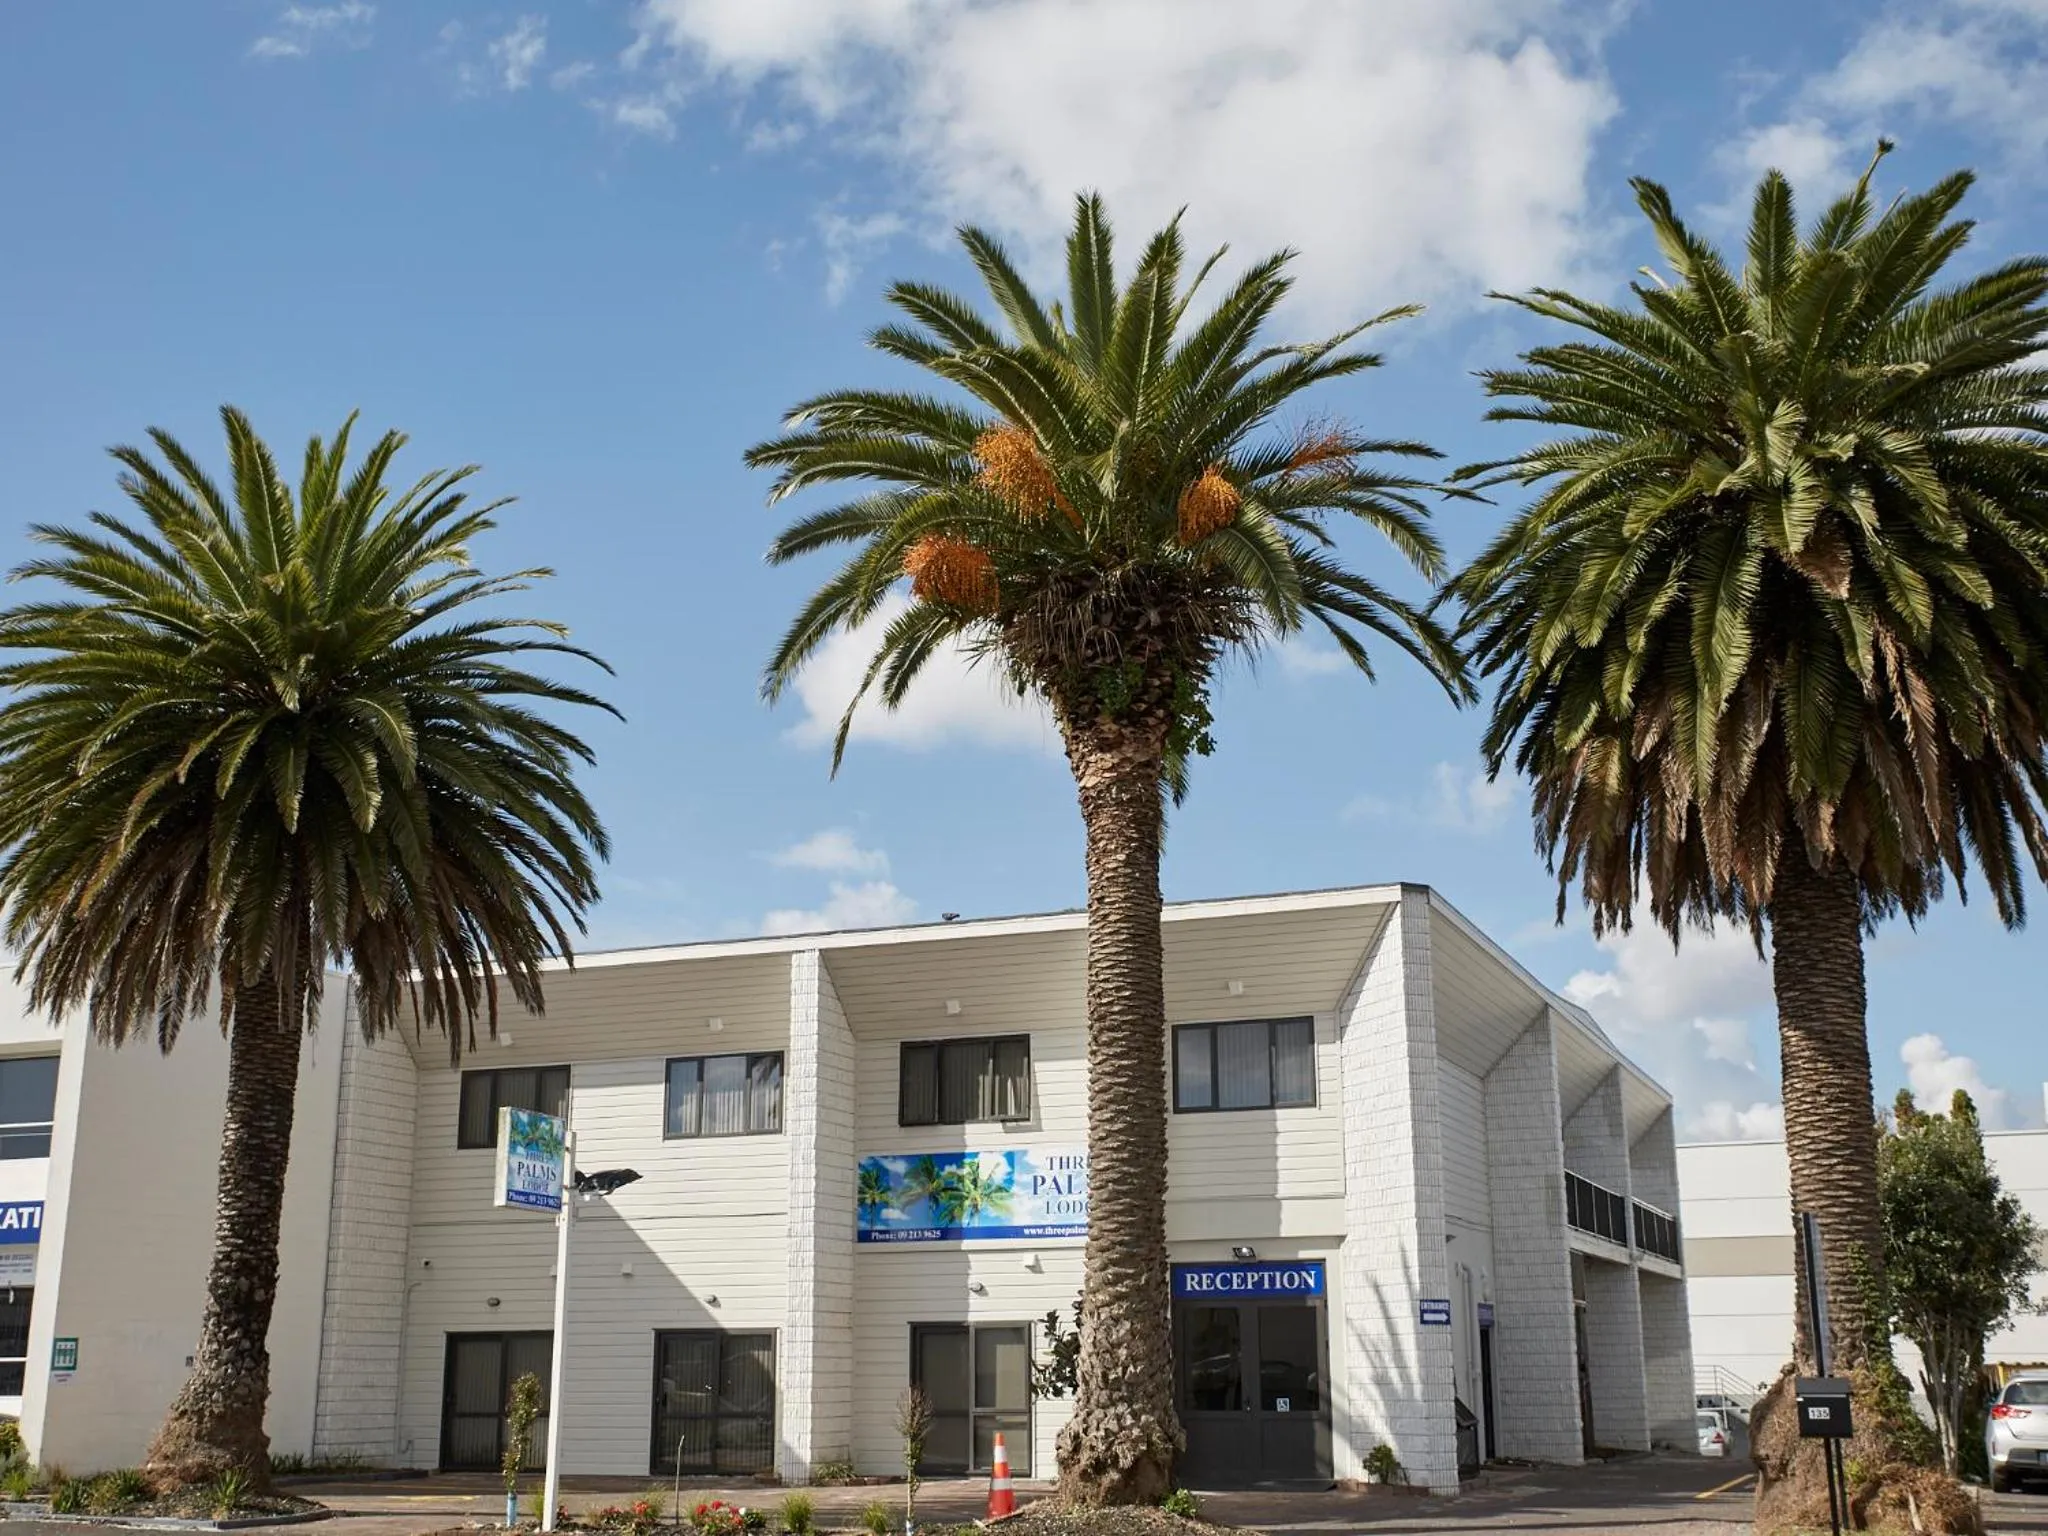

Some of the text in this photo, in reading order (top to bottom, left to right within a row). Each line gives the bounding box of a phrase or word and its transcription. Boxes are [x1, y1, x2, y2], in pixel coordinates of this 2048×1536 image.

[517, 1161, 557, 1182] PALMS
[1046, 1155, 1090, 1170] THR
[1032, 1174, 1088, 1195] PAL
[1045, 1200, 1088, 1214] LOD
[0, 1206, 41, 1229] ATI
[1184, 1271, 1317, 1291] RECEPTION
[1811, 1409, 1829, 1417] 135
